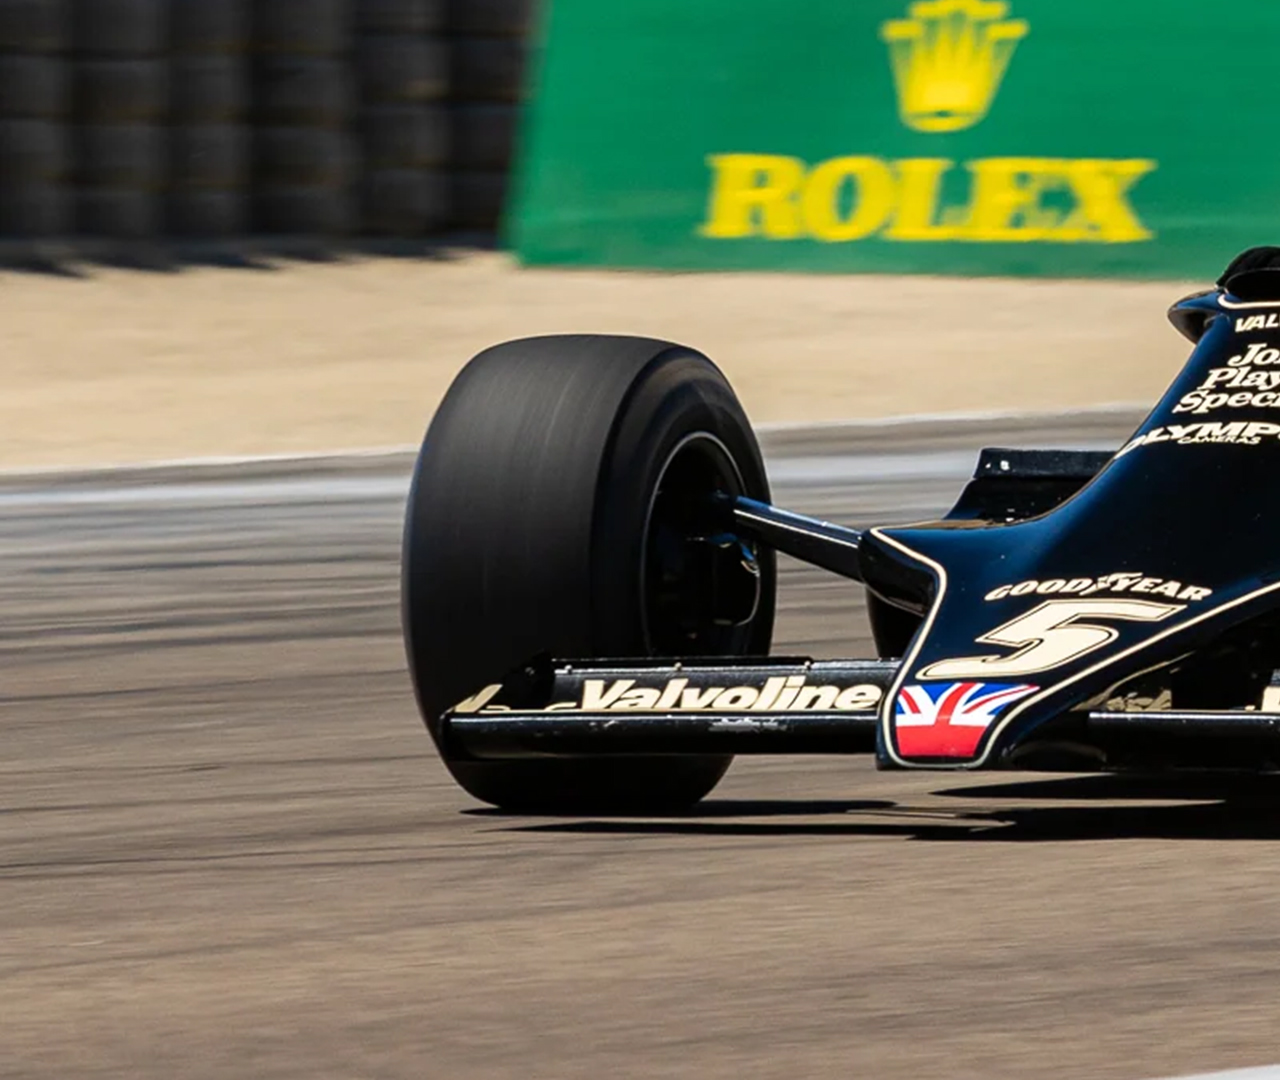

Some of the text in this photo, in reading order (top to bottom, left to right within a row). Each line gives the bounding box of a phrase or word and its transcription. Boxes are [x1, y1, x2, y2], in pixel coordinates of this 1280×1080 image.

[698, 152, 1157, 242] ROLEX
[1177, 435, 1262, 445] CAMERAS
[984, 572, 1213, 601] GOODYEAR
[916, 598, 1189, 681] 5
[582, 675, 882, 711] Valvoline
